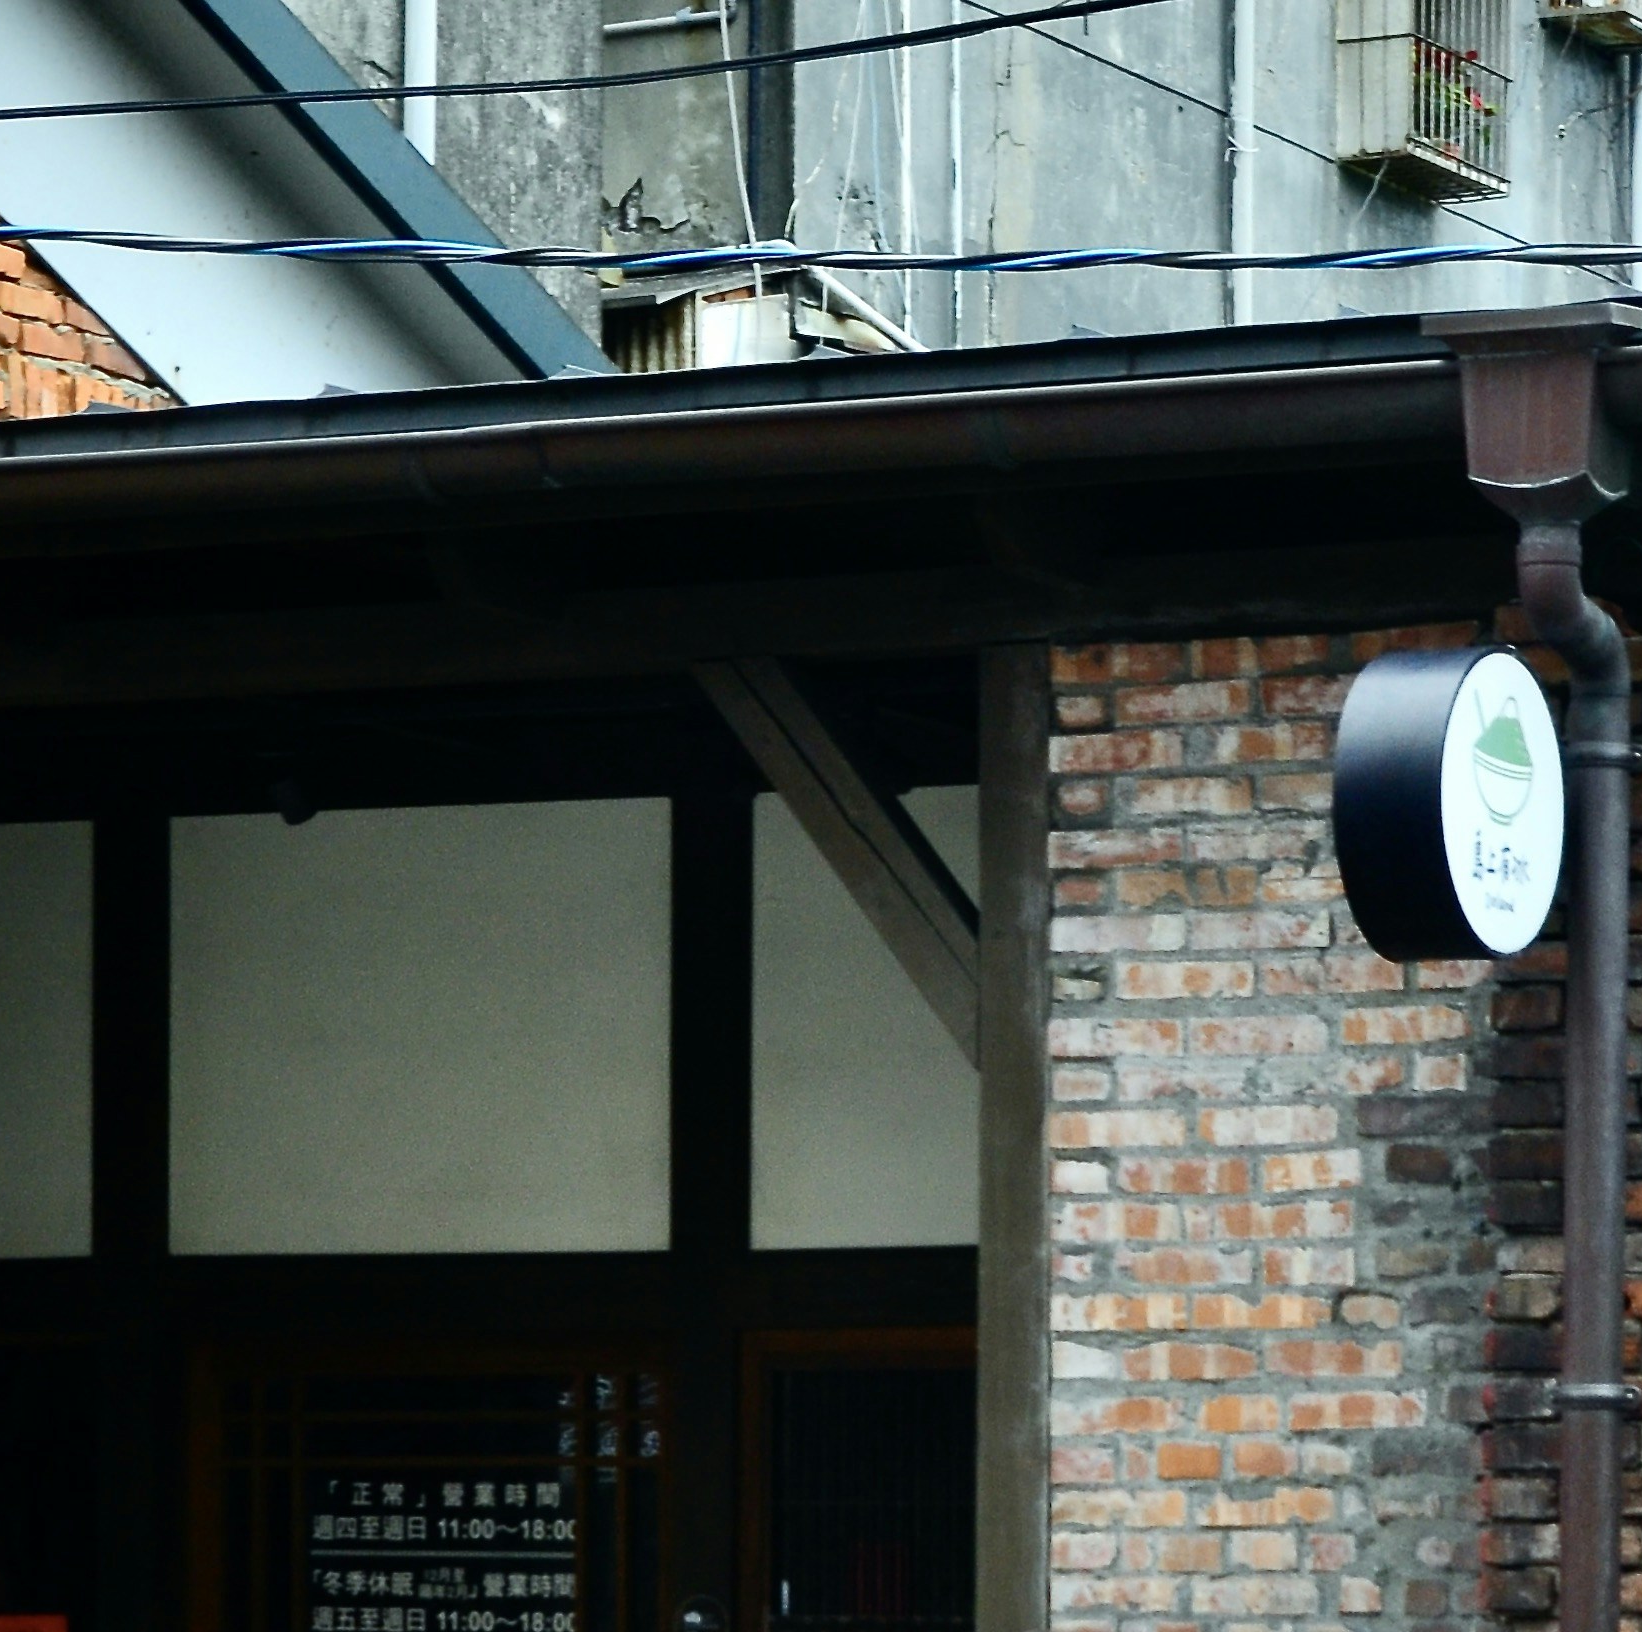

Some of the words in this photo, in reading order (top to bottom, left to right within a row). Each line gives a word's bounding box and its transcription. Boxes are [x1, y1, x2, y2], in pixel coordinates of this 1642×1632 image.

[313, 1515, 427, 1541] 週四至週日
[483, 1573, 576, 1599] 營業時間
[312, 1606, 426, 1632] 週五至週日
